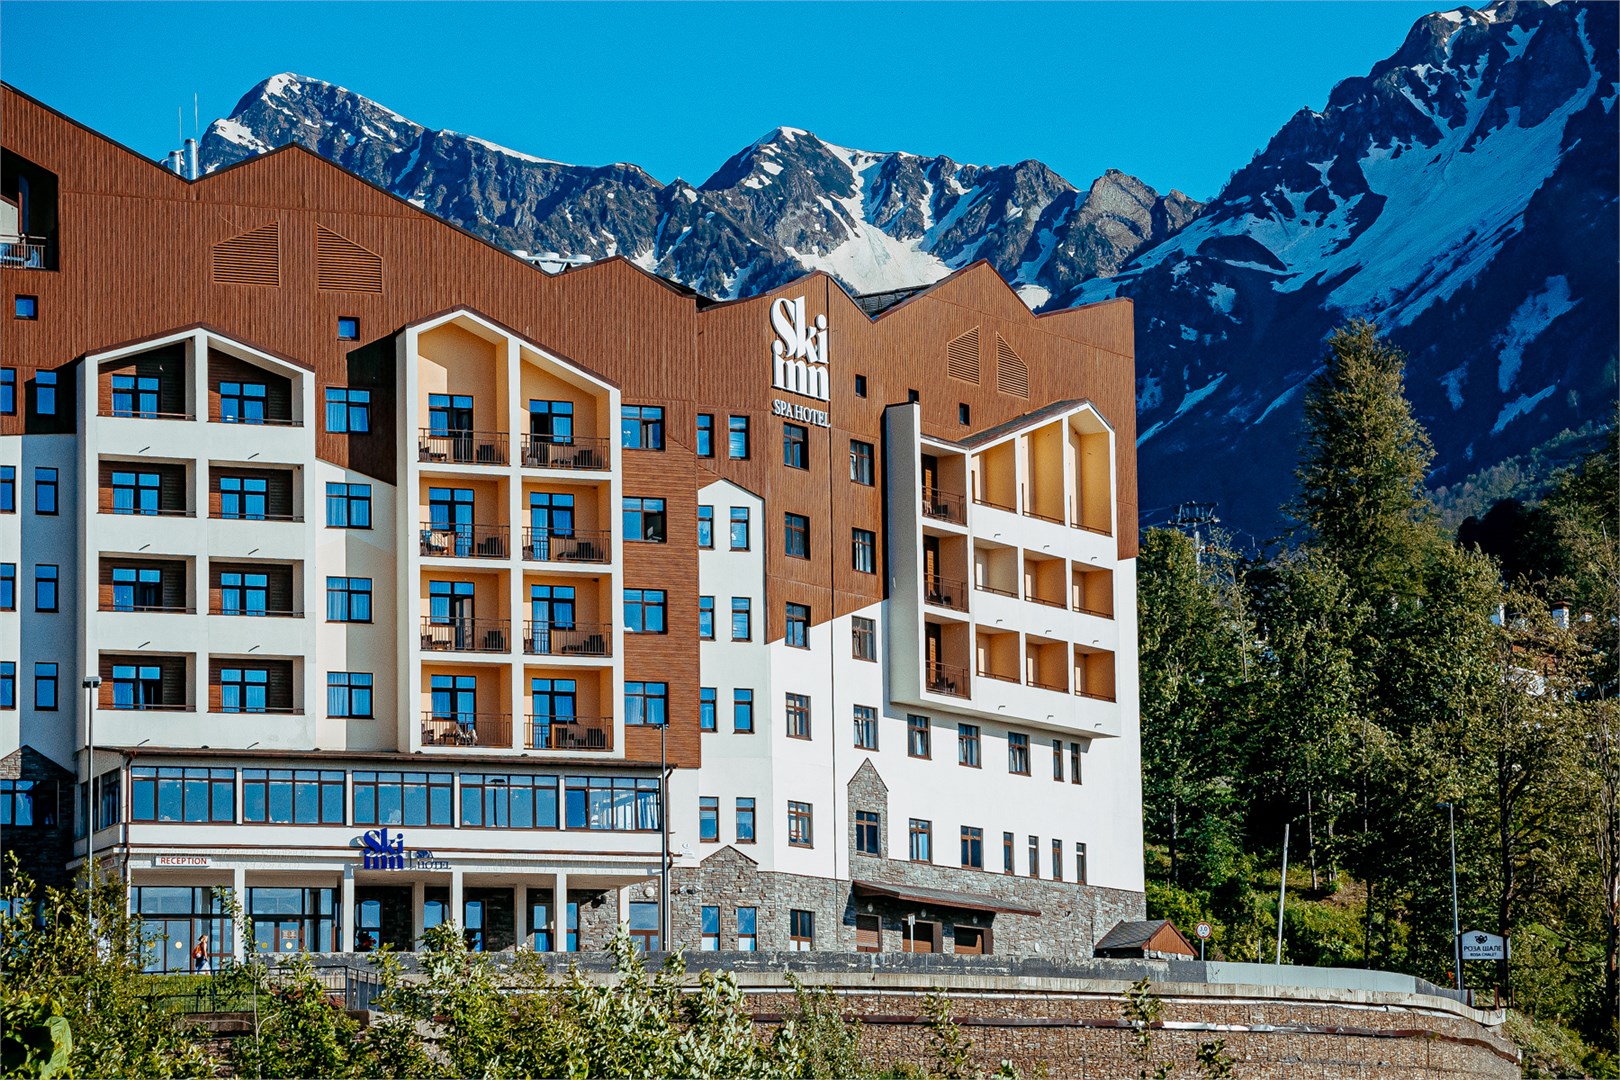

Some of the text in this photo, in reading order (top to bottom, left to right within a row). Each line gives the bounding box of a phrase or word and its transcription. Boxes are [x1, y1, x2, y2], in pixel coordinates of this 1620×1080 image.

[771, 296, 829, 364] Ski
[771, 339, 831, 402] inn
[773, 399, 831, 428] SPA HOTEL
[363, 828, 404, 855] Ski
[160, 857, 208, 865] RECEPTION
[363, 847, 404, 870] inn
[417, 861, 452, 870] HOTEL
